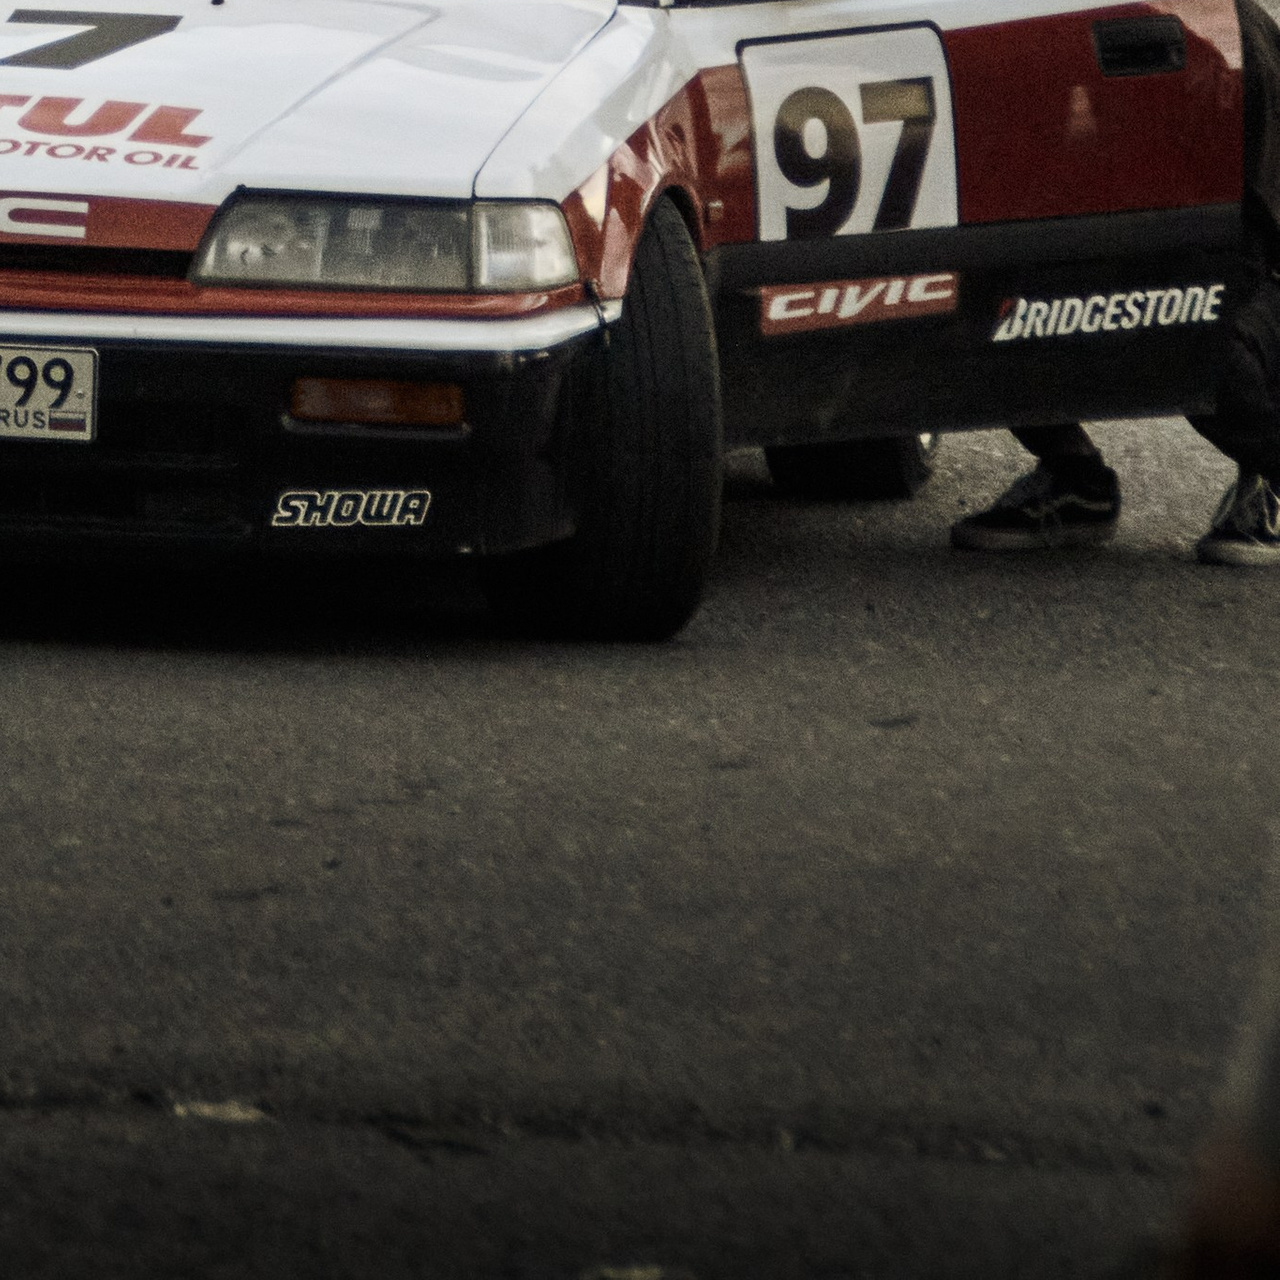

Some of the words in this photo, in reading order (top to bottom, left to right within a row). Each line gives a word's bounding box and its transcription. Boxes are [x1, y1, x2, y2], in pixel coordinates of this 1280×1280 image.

[123, 150, 201, 171] OIL
[773, 76, 937, 239] 97
[769, 273, 954, 320] CIVIC
[992, 284, 1226, 342] BRIDGESTONE
[272, 491, 432, 526] SHOWA
